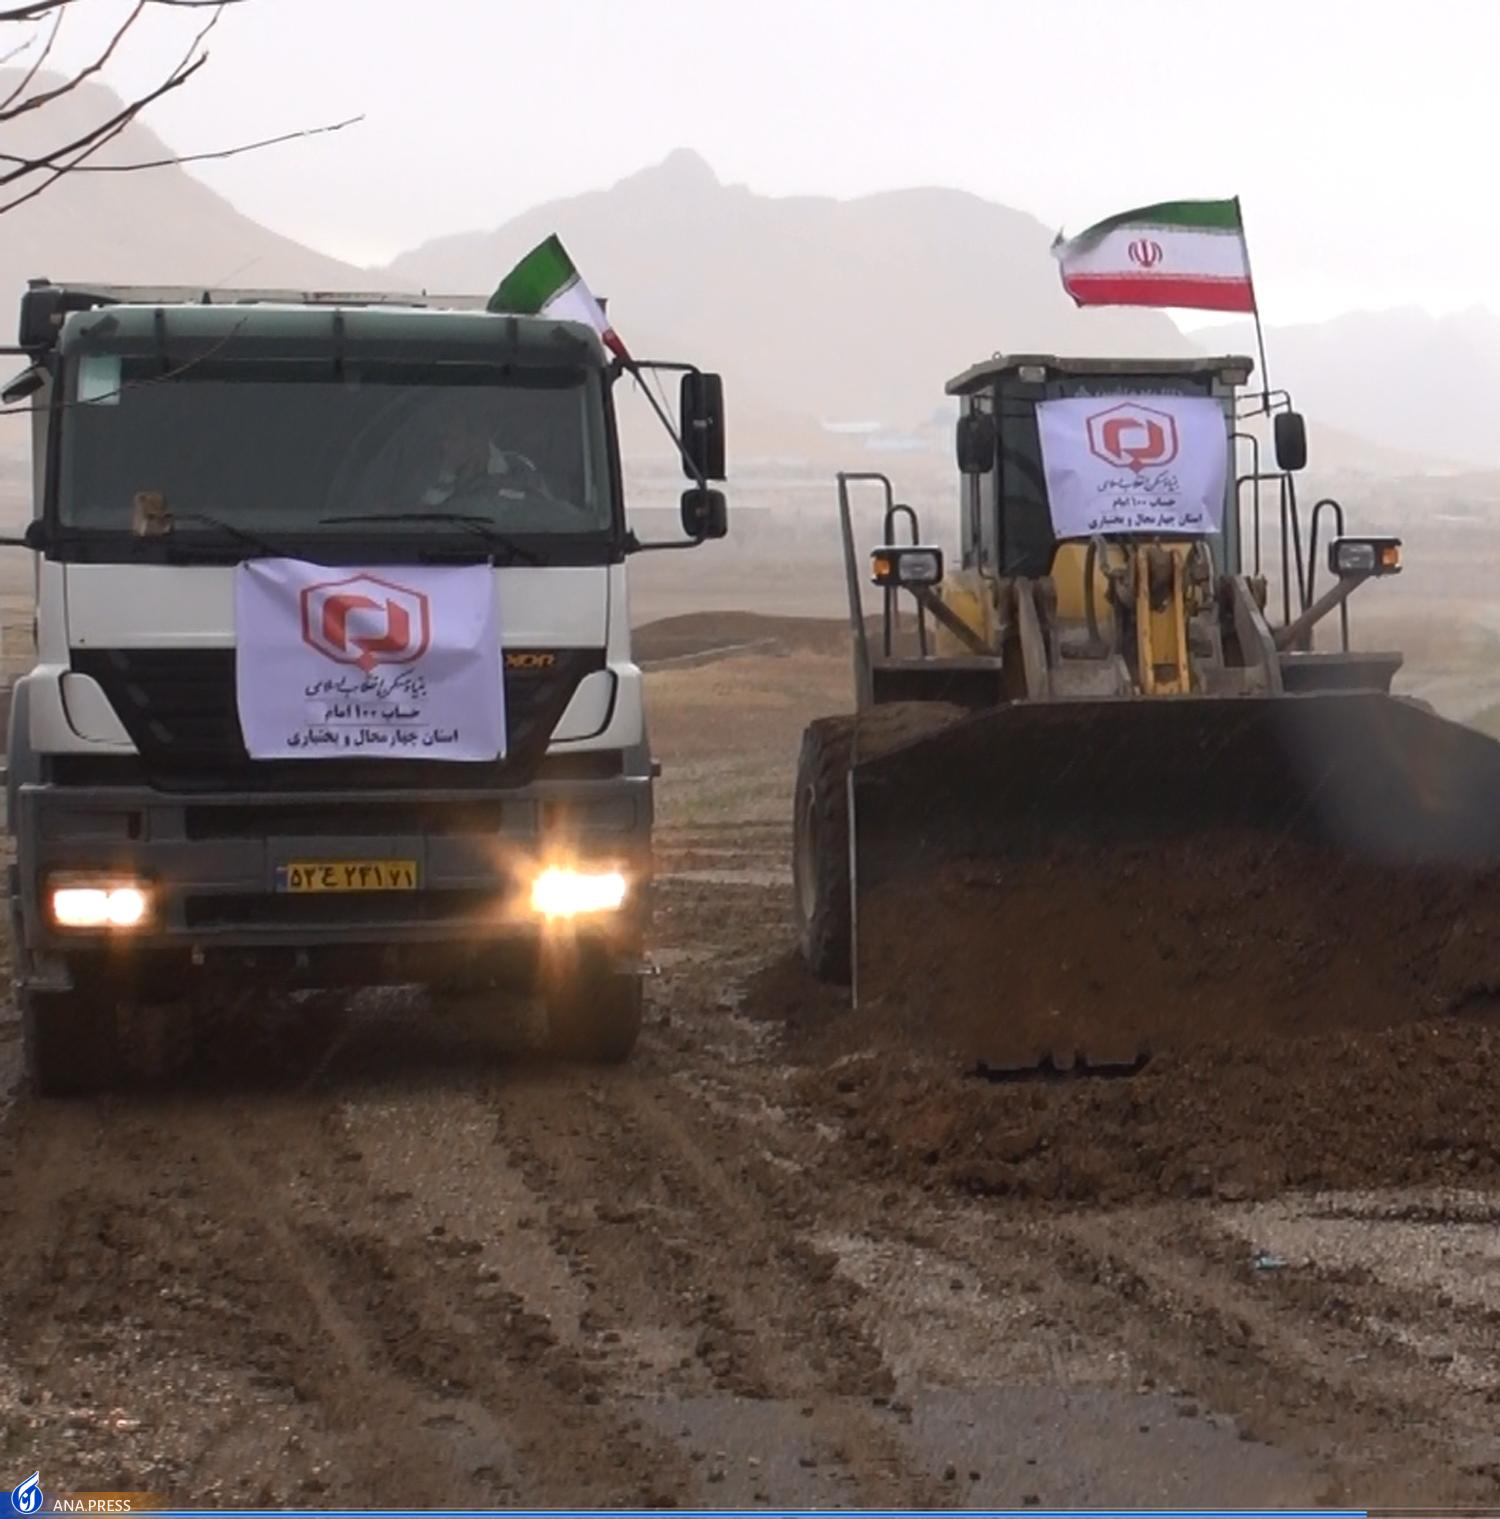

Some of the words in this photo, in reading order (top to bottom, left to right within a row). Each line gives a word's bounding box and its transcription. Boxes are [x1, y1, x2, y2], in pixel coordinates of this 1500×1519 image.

[324, 704, 351, 722] امام
[381, 704, 420, 722] حساب
[287, 728, 339, 748] بختیاری
[422, 729, 459, 747] استان
